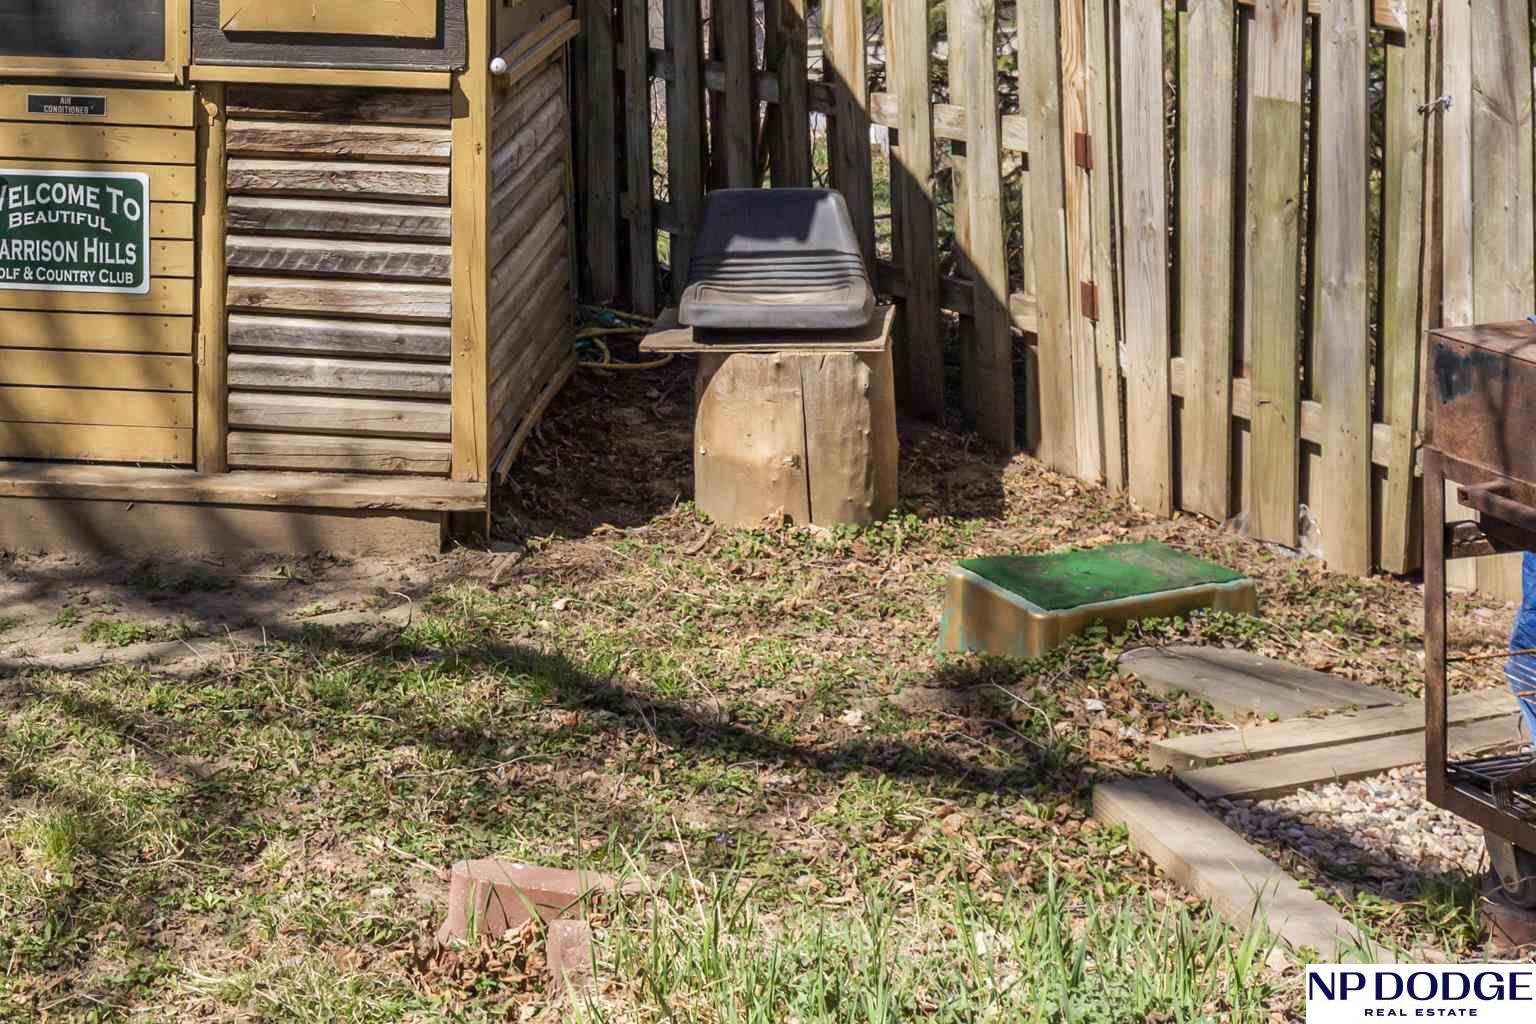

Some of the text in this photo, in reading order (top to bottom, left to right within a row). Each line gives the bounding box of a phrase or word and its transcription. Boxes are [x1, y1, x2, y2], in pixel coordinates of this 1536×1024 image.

[59, 96, 72, 105] AIR
[106, 184, 141, 222] TO
[8, 210, 112, 233] BEAUTIFUL
[83, 237, 137, 266] HILLS
[23, 266, 33, 281] &
[36, 267, 97, 283] COUNTRY
[98, 269, 134, 285] CLUB
